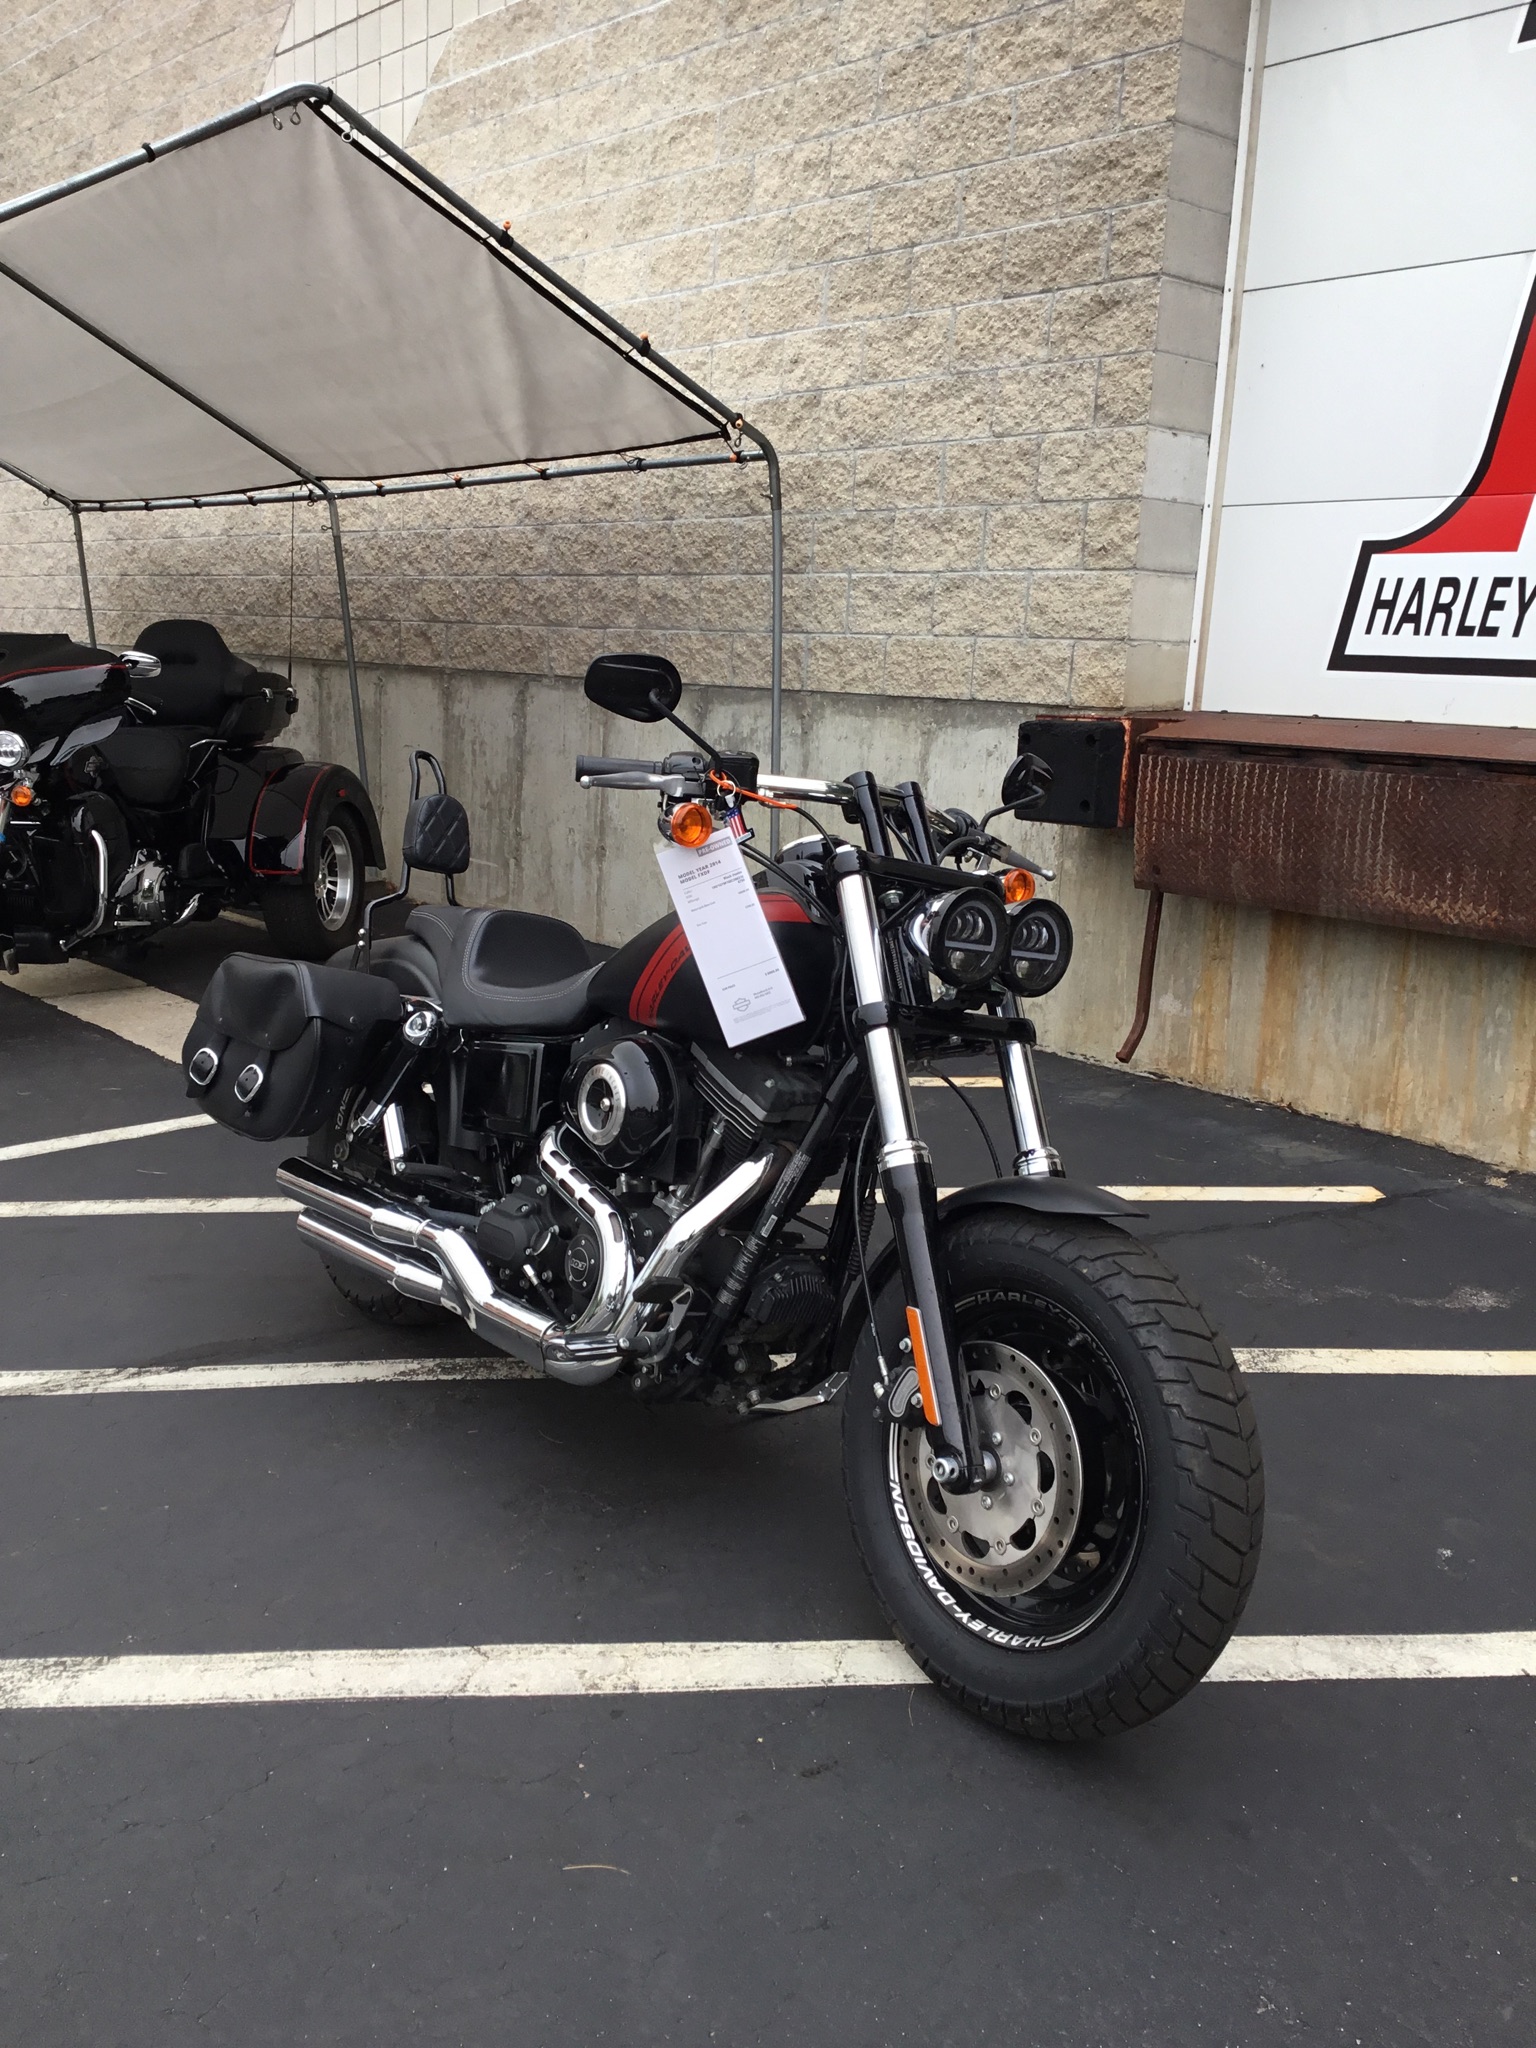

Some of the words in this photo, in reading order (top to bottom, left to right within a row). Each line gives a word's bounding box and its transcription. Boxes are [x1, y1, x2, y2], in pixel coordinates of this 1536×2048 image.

[1364, 576, 1536, 638] HARLEY
[699, 839, 731, 855] PRE-OWNED
[678, 870, 695, 879] MODEL
[696, 864, 709, 873] YEAR
[679, 874, 696, 884] MODEL
[890, 1481, 1047, 1649] HARLEY-DAVIDSON
